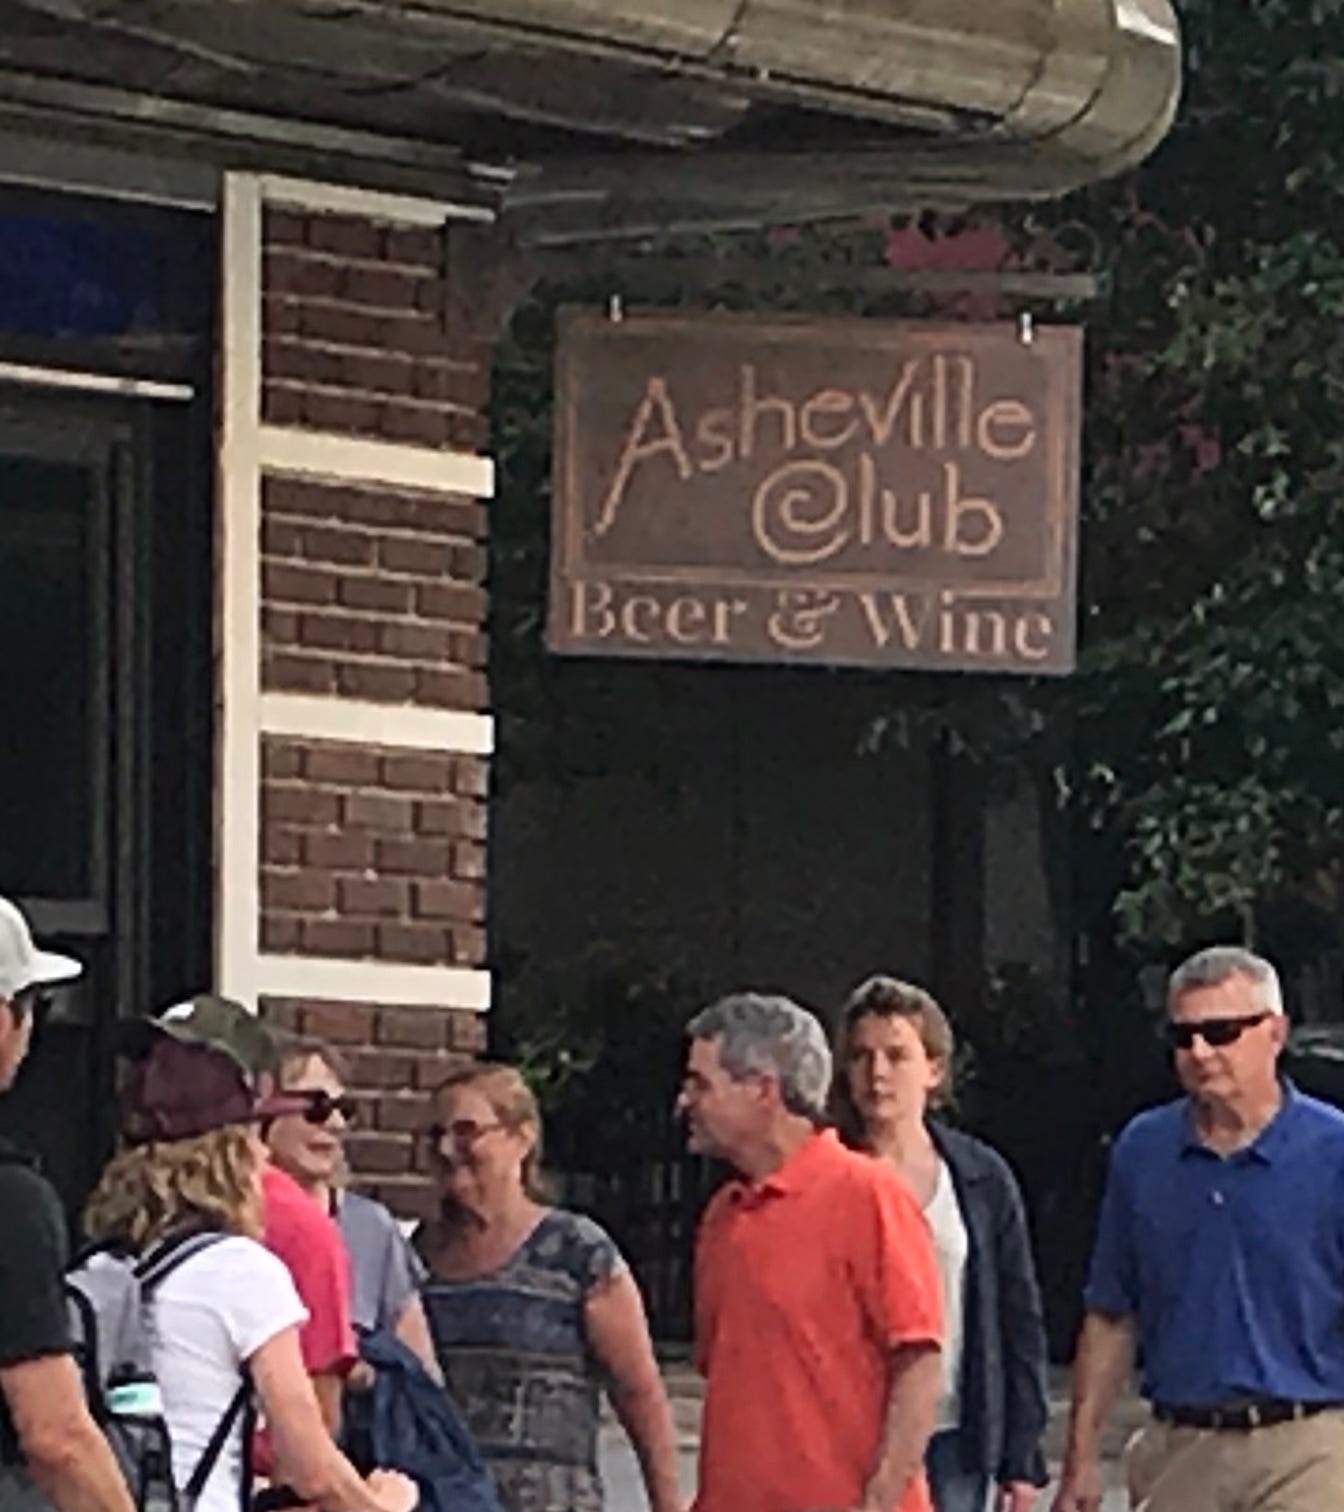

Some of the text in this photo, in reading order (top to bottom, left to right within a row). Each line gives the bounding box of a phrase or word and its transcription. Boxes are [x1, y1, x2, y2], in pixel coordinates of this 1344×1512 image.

[590, 353, 1036, 541] Asheville
[752, 452, 1003, 563] Club
[571, 579, 1054, 659] Beer & Wine
